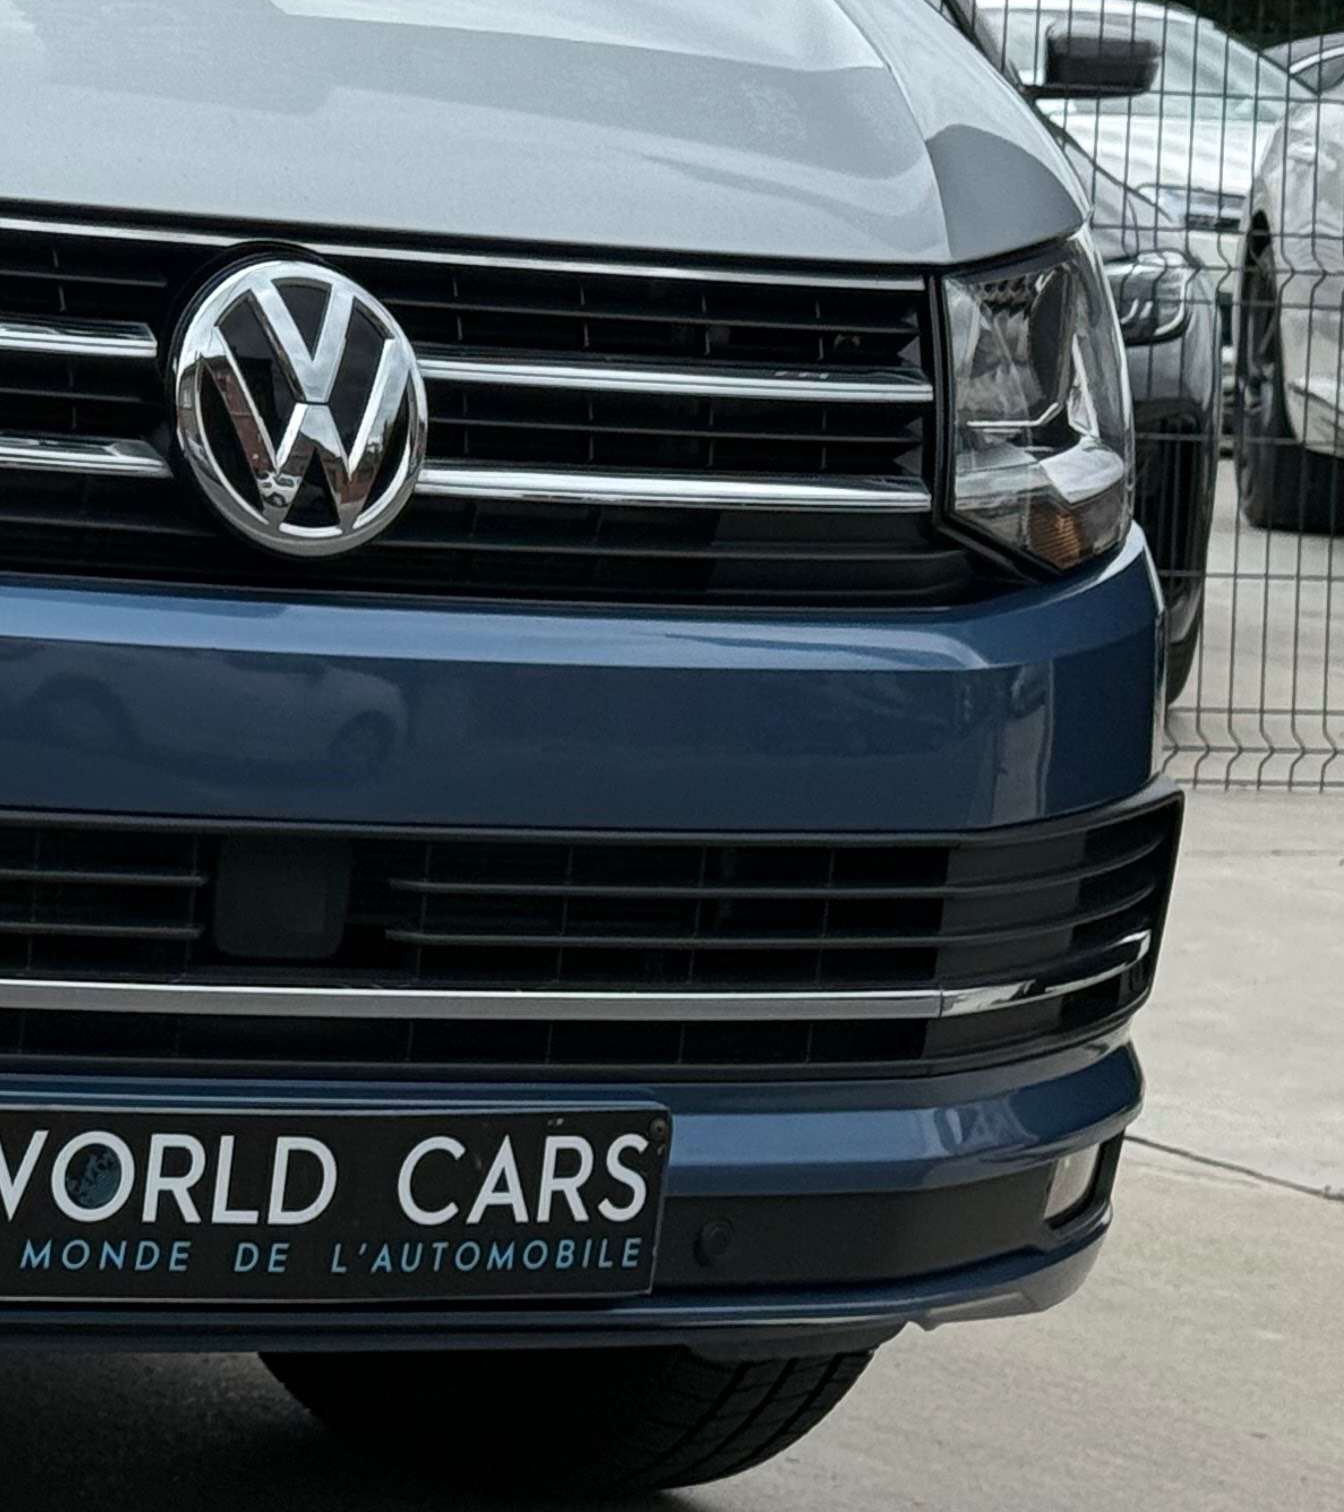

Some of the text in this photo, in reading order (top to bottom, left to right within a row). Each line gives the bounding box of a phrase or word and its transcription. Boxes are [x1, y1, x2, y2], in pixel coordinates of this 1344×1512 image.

[178, 262, 426, 554] VW
[397, 1133, 649, 1225] CARS
[18, 1239, 191, 1273] MONDE
[233, 1241, 291, 1274] DE
[330, 1237, 643, 1274] L'AUTOMOBILE
